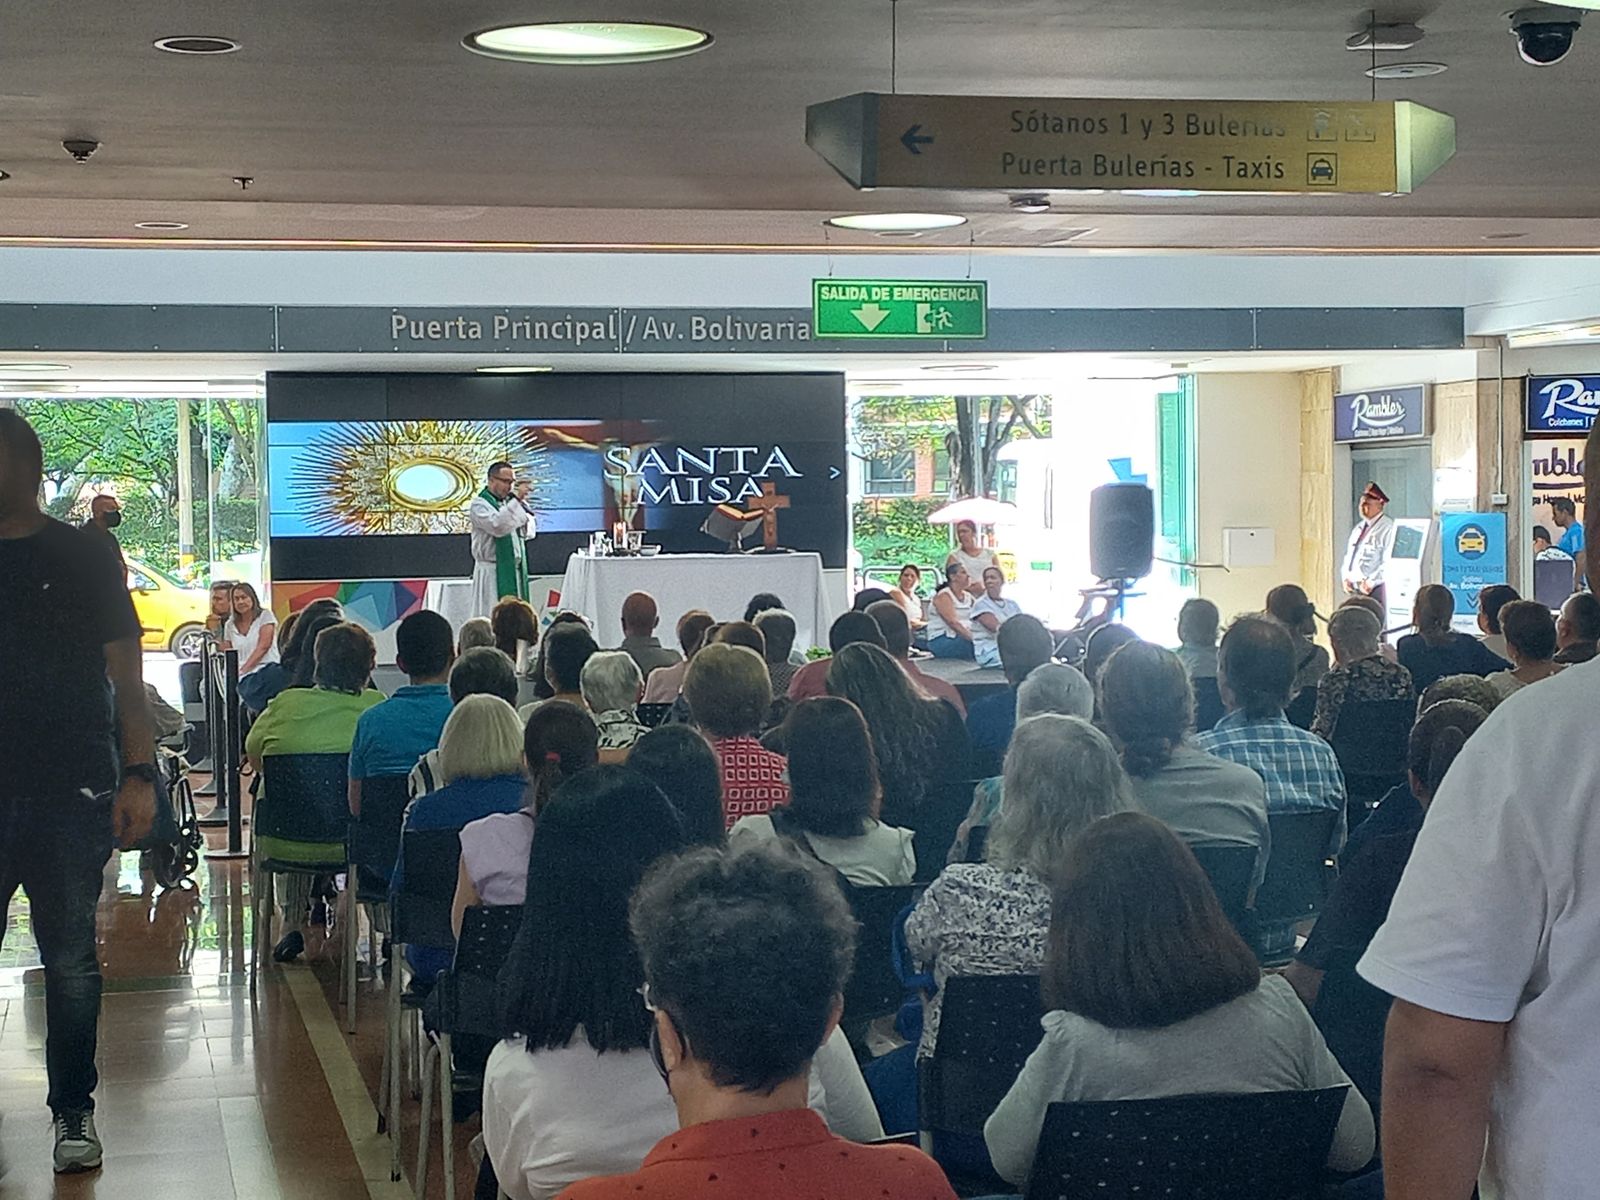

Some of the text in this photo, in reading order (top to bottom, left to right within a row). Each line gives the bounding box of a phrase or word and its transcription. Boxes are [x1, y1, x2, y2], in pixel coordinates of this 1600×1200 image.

[1010, 109, 1109, 134] Sótanos
[1119, 112, 1129, 135] 1
[1140, 116, 1153, 140] y
[1162, 113, 1175, 135] 3
[1002, 151, 1083, 176] Puerta
[1093, 153, 1195, 178] Bulerías
[1222, 155, 1285, 179] Taxis
[821, 286, 979, 302] SALIDA DE EMERGENCIA
[391, 314, 482, 340] Puerta
[494, 314, 617, 346] Principal
[691, 315, 811, 341] Bolivaria
[1350, 394, 1406, 431] Rambler
[603, 446, 803, 479] SANTA
[632, 476, 765, 506] MISA
